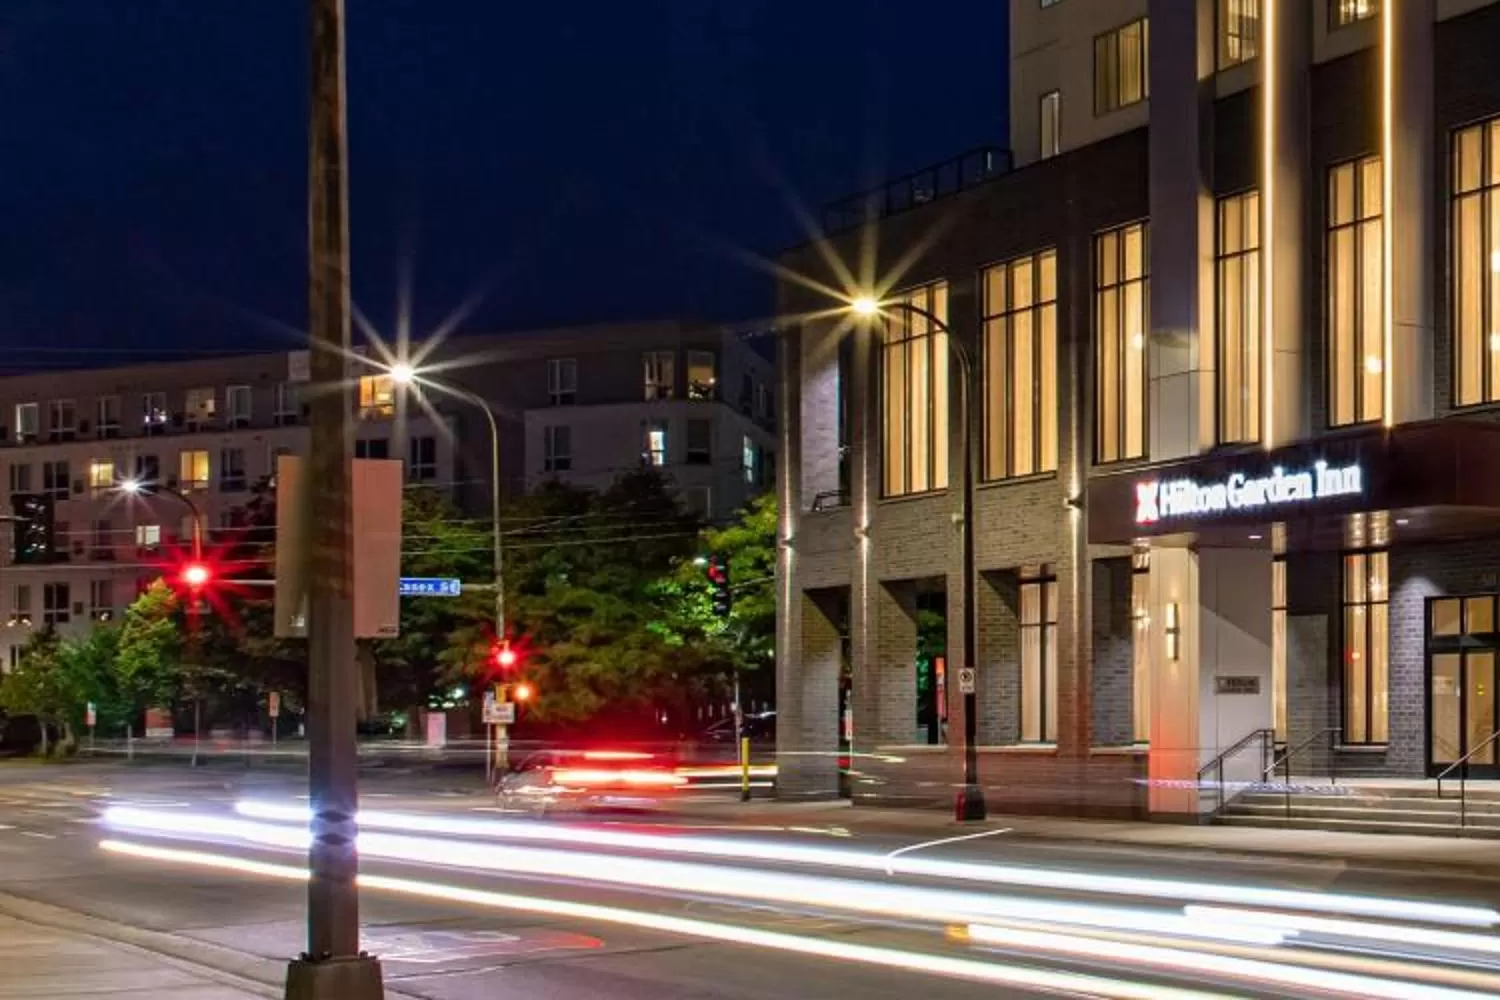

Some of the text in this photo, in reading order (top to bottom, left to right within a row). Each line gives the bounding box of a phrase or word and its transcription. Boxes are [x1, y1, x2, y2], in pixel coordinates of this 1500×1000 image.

[1160, 459, 1362, 516] Hilton Garden Inn
